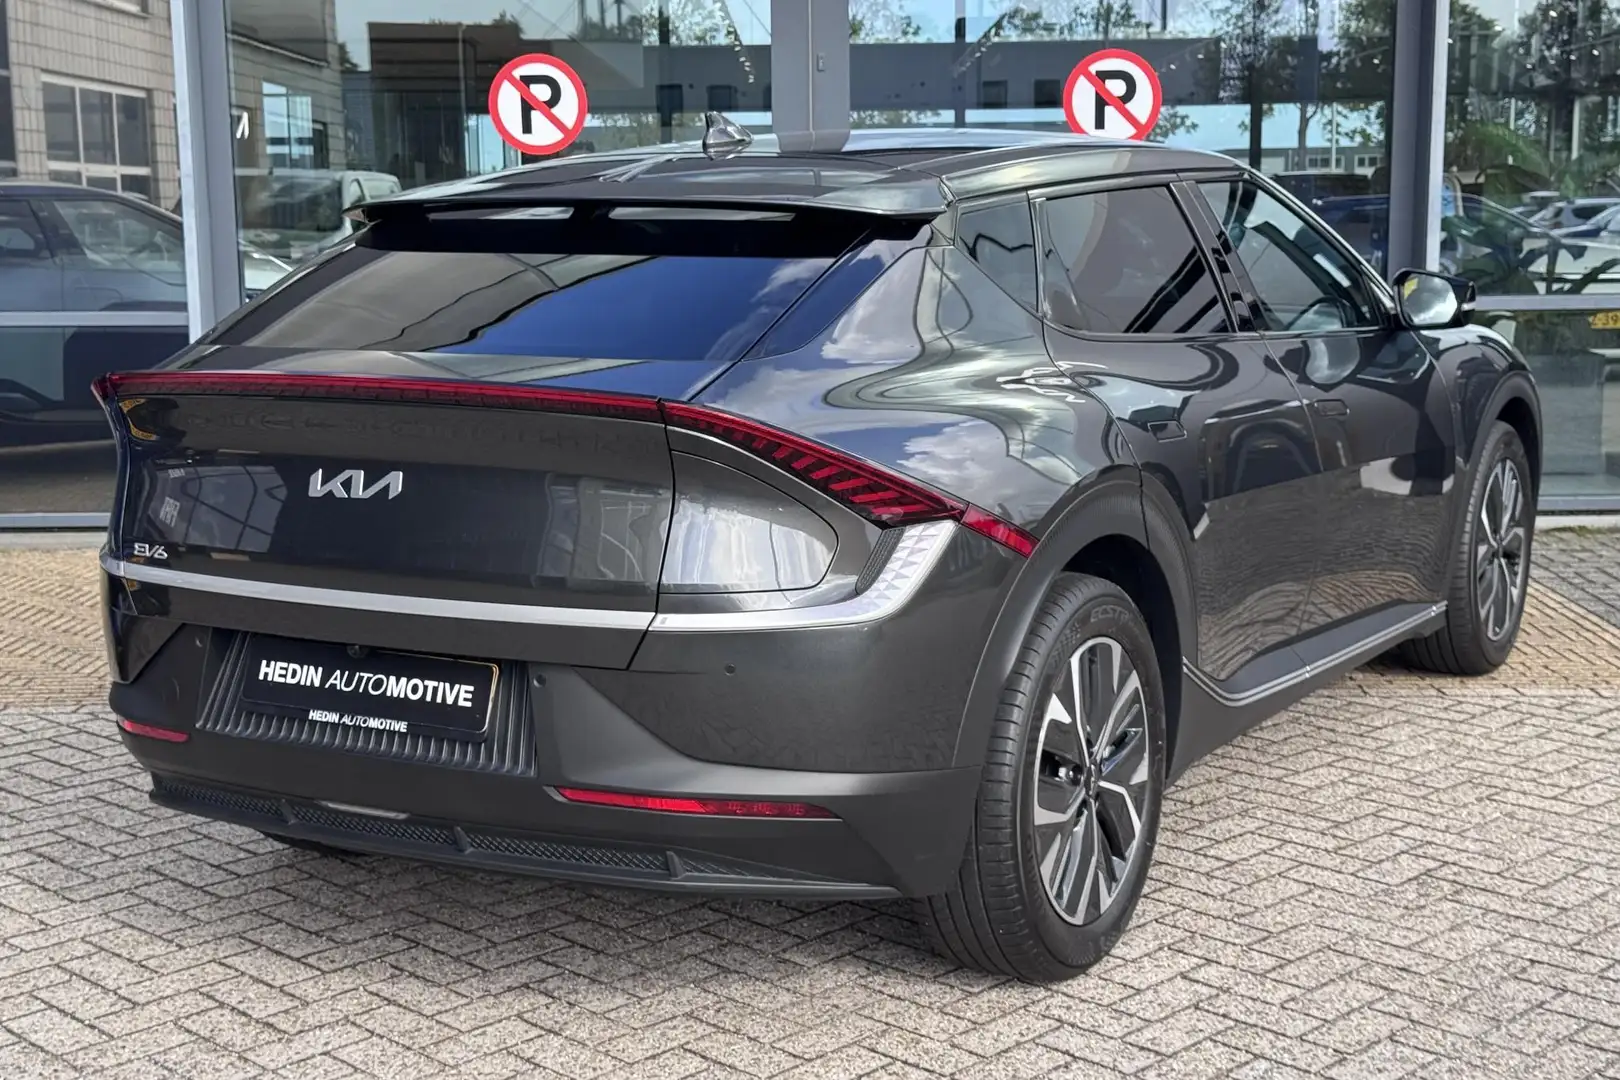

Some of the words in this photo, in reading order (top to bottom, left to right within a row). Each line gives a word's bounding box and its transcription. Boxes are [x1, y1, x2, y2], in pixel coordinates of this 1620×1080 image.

[519, 74, 562, 135] P
[1094, 70, 1137, 130] P
[308, 468, 403, 500] KIA
[134, 542, 168, 560] EV6
[258, 659, 323, 688] HEDIN
[325, 669, 475, 708] AUTOMOTIVE
[308, 709, 340, 724] HEDIN
[340, 713, 408, 733] AUTOMOTIVE
